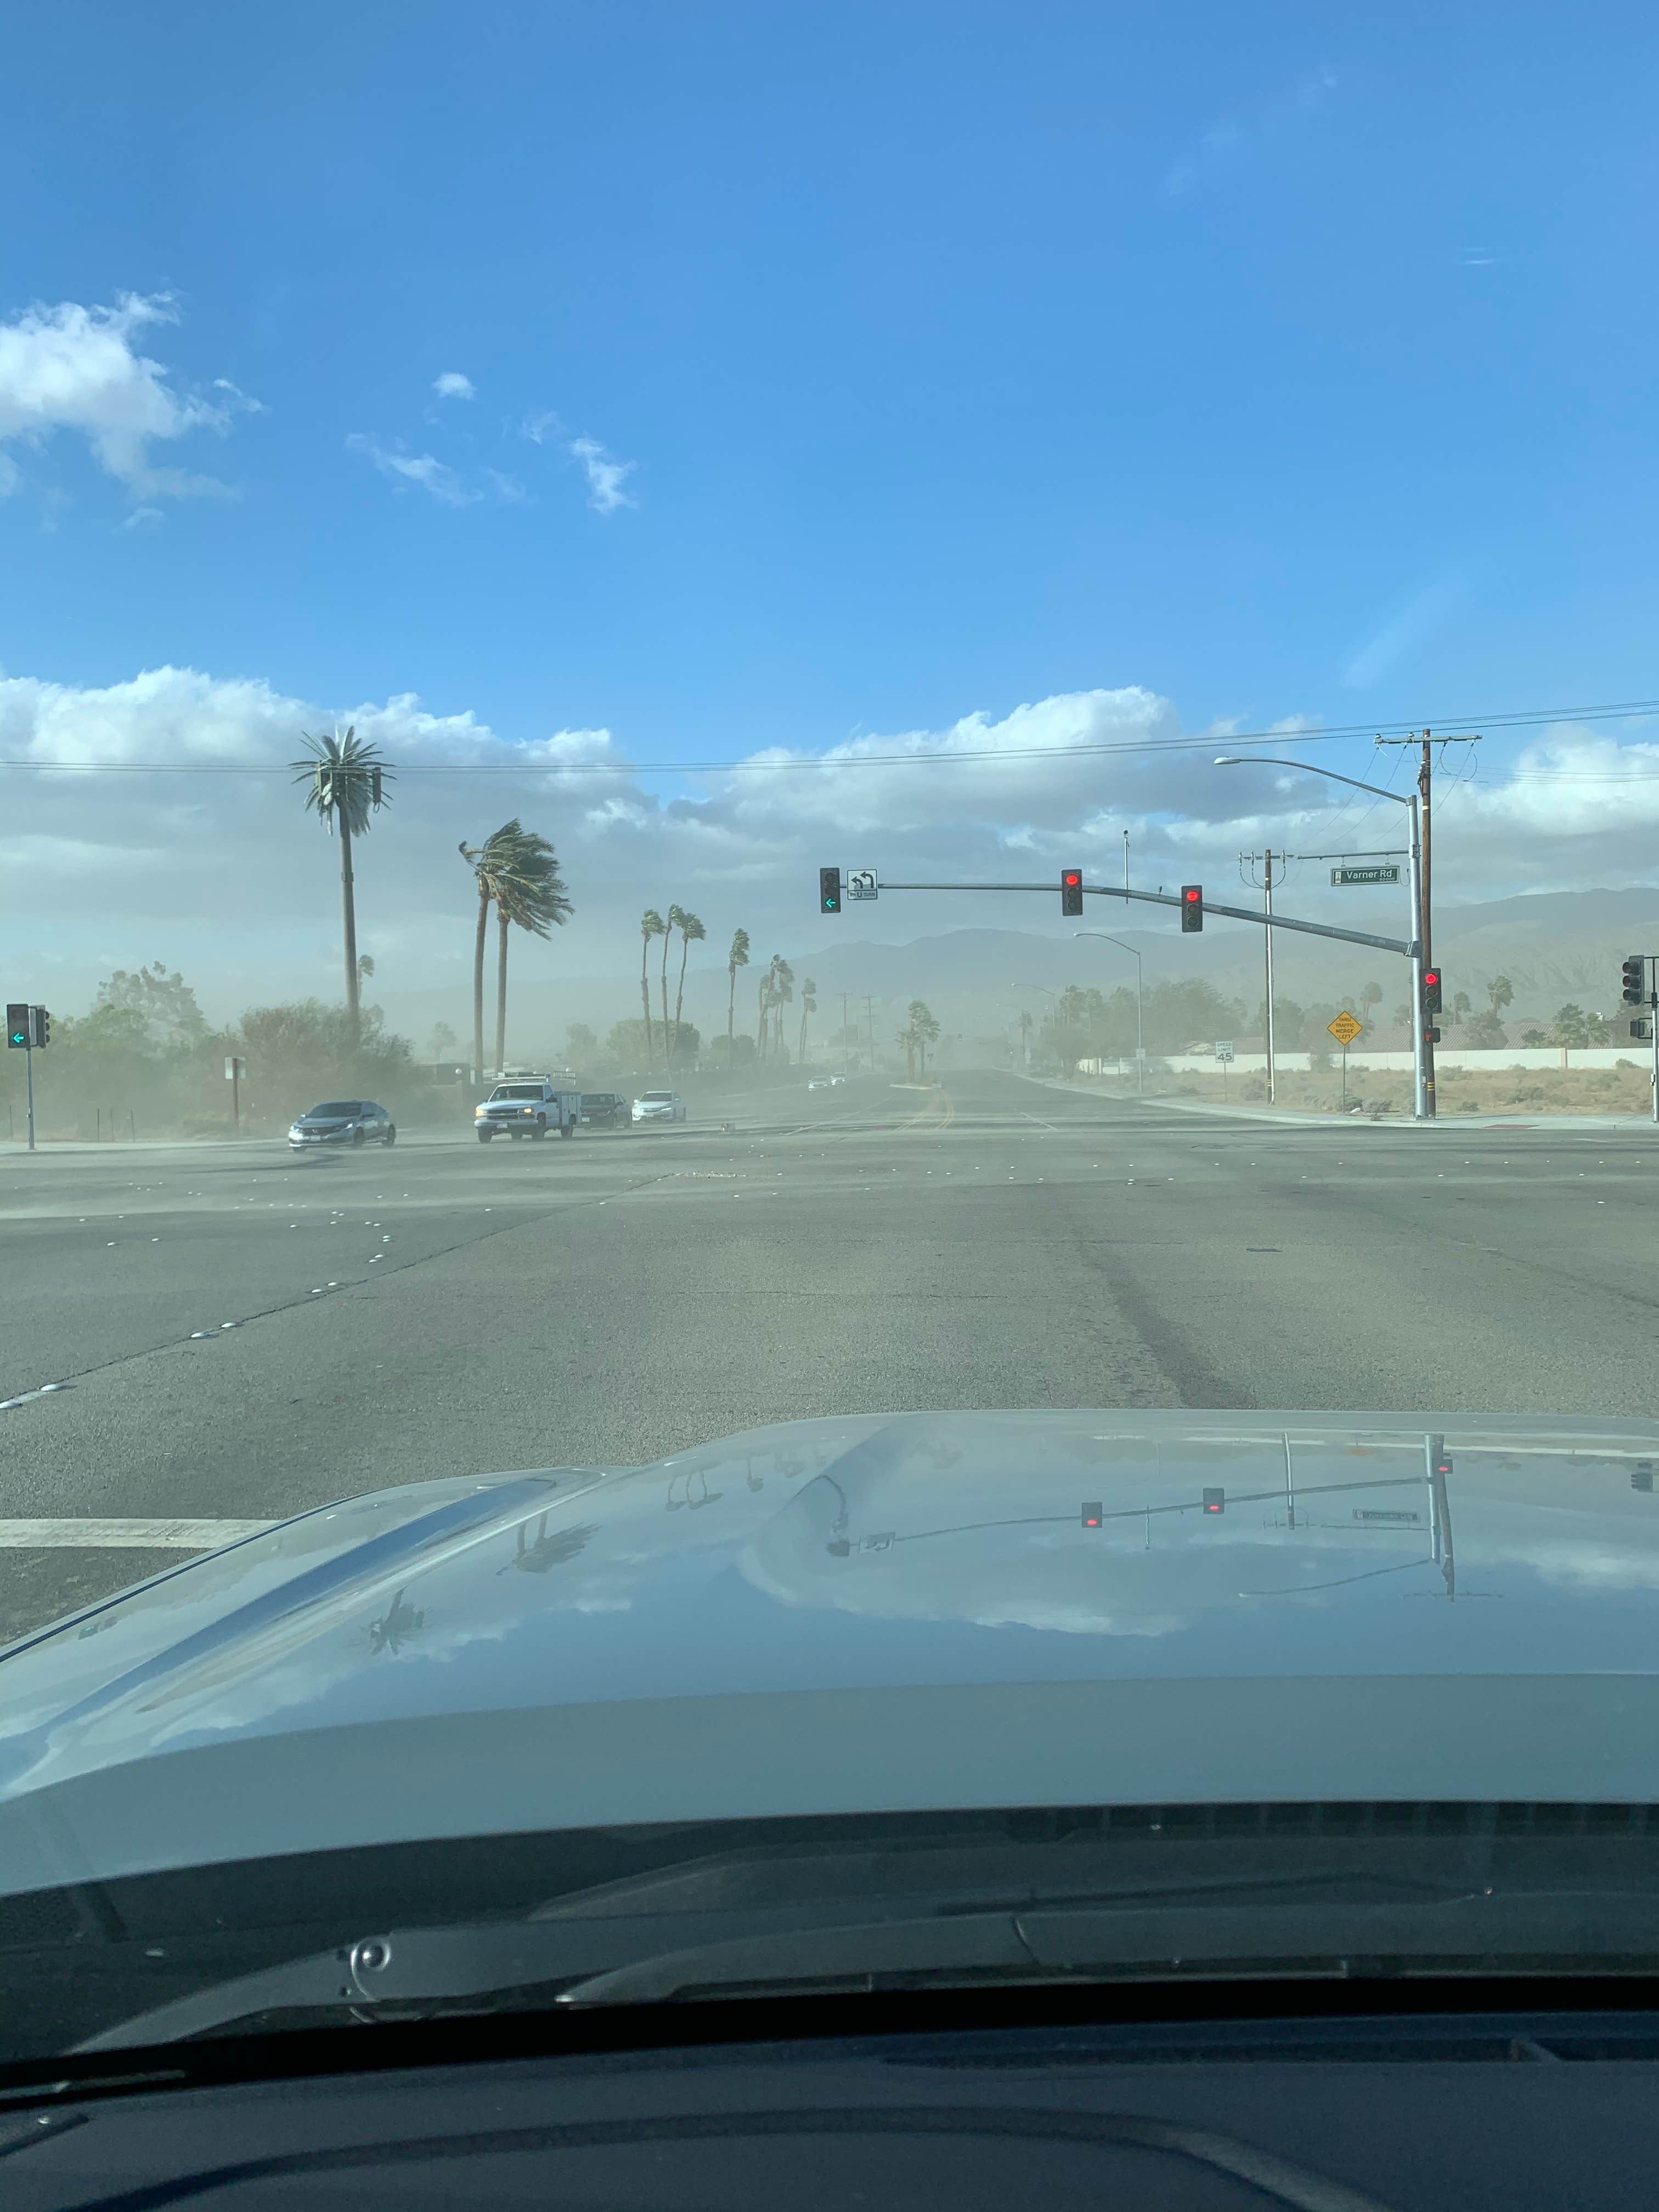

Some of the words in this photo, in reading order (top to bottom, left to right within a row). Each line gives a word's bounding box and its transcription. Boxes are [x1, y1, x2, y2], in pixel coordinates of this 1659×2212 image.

[1346, 871, 1378, 879] Varner
[1380, 870, 1392, 878] Rd
[1217, 1053, 1232, 1061] 45
